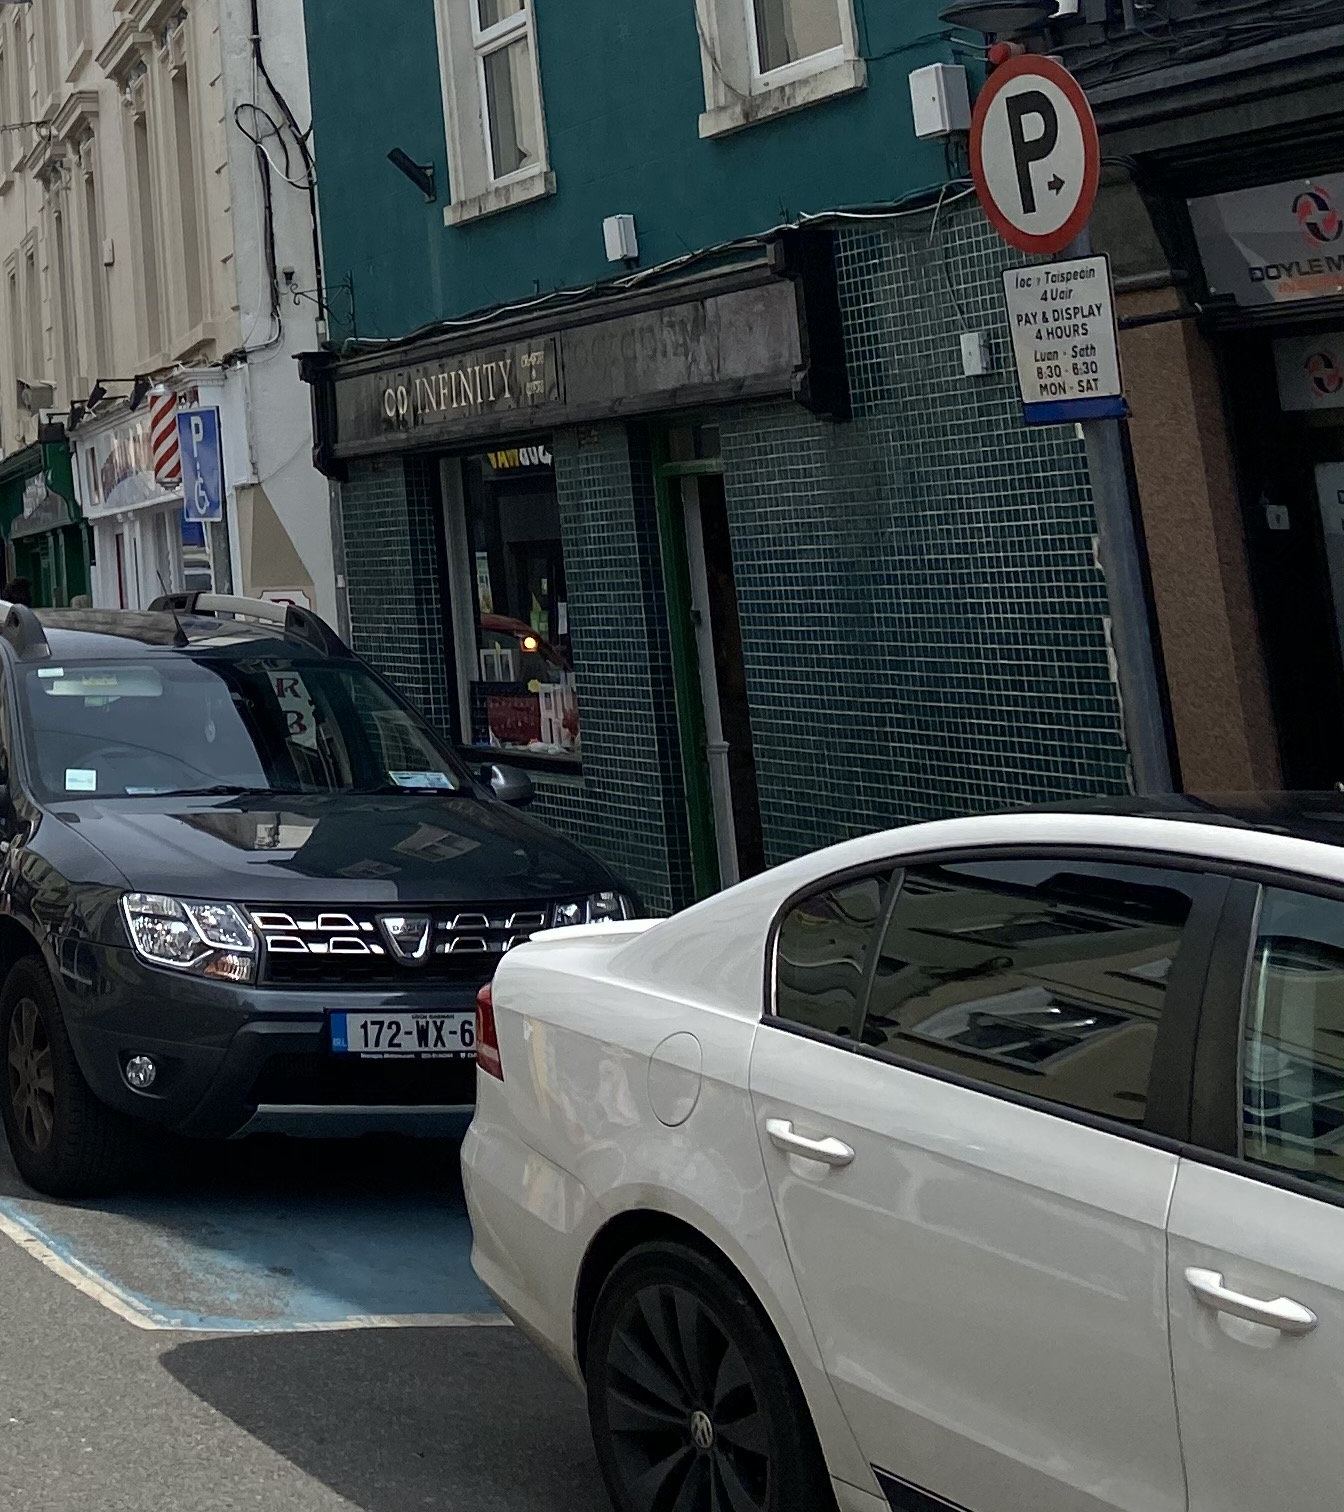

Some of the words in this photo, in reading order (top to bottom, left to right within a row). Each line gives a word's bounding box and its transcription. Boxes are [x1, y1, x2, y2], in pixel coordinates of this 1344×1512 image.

[1005, 90, 1059, 215] P
[1040, 290, 1048, 302] 4
[1016, 311, 1038, 326] PAY
[1042, 311, 1049, 323] &
[1052, 303, 1102, 322] DISPLAY
[1035, 329, 1043, 340] 4
[1046, 323, 1089, 340] HOURS
[1034, 349, 1059, 362] Luan
[1071, 344, 1096, 358] Sath
[415, 359, 512, 414] INFINITY
[1039, 381, 1067, 396] MON
[1077, 378, 1099, 393] SAT
